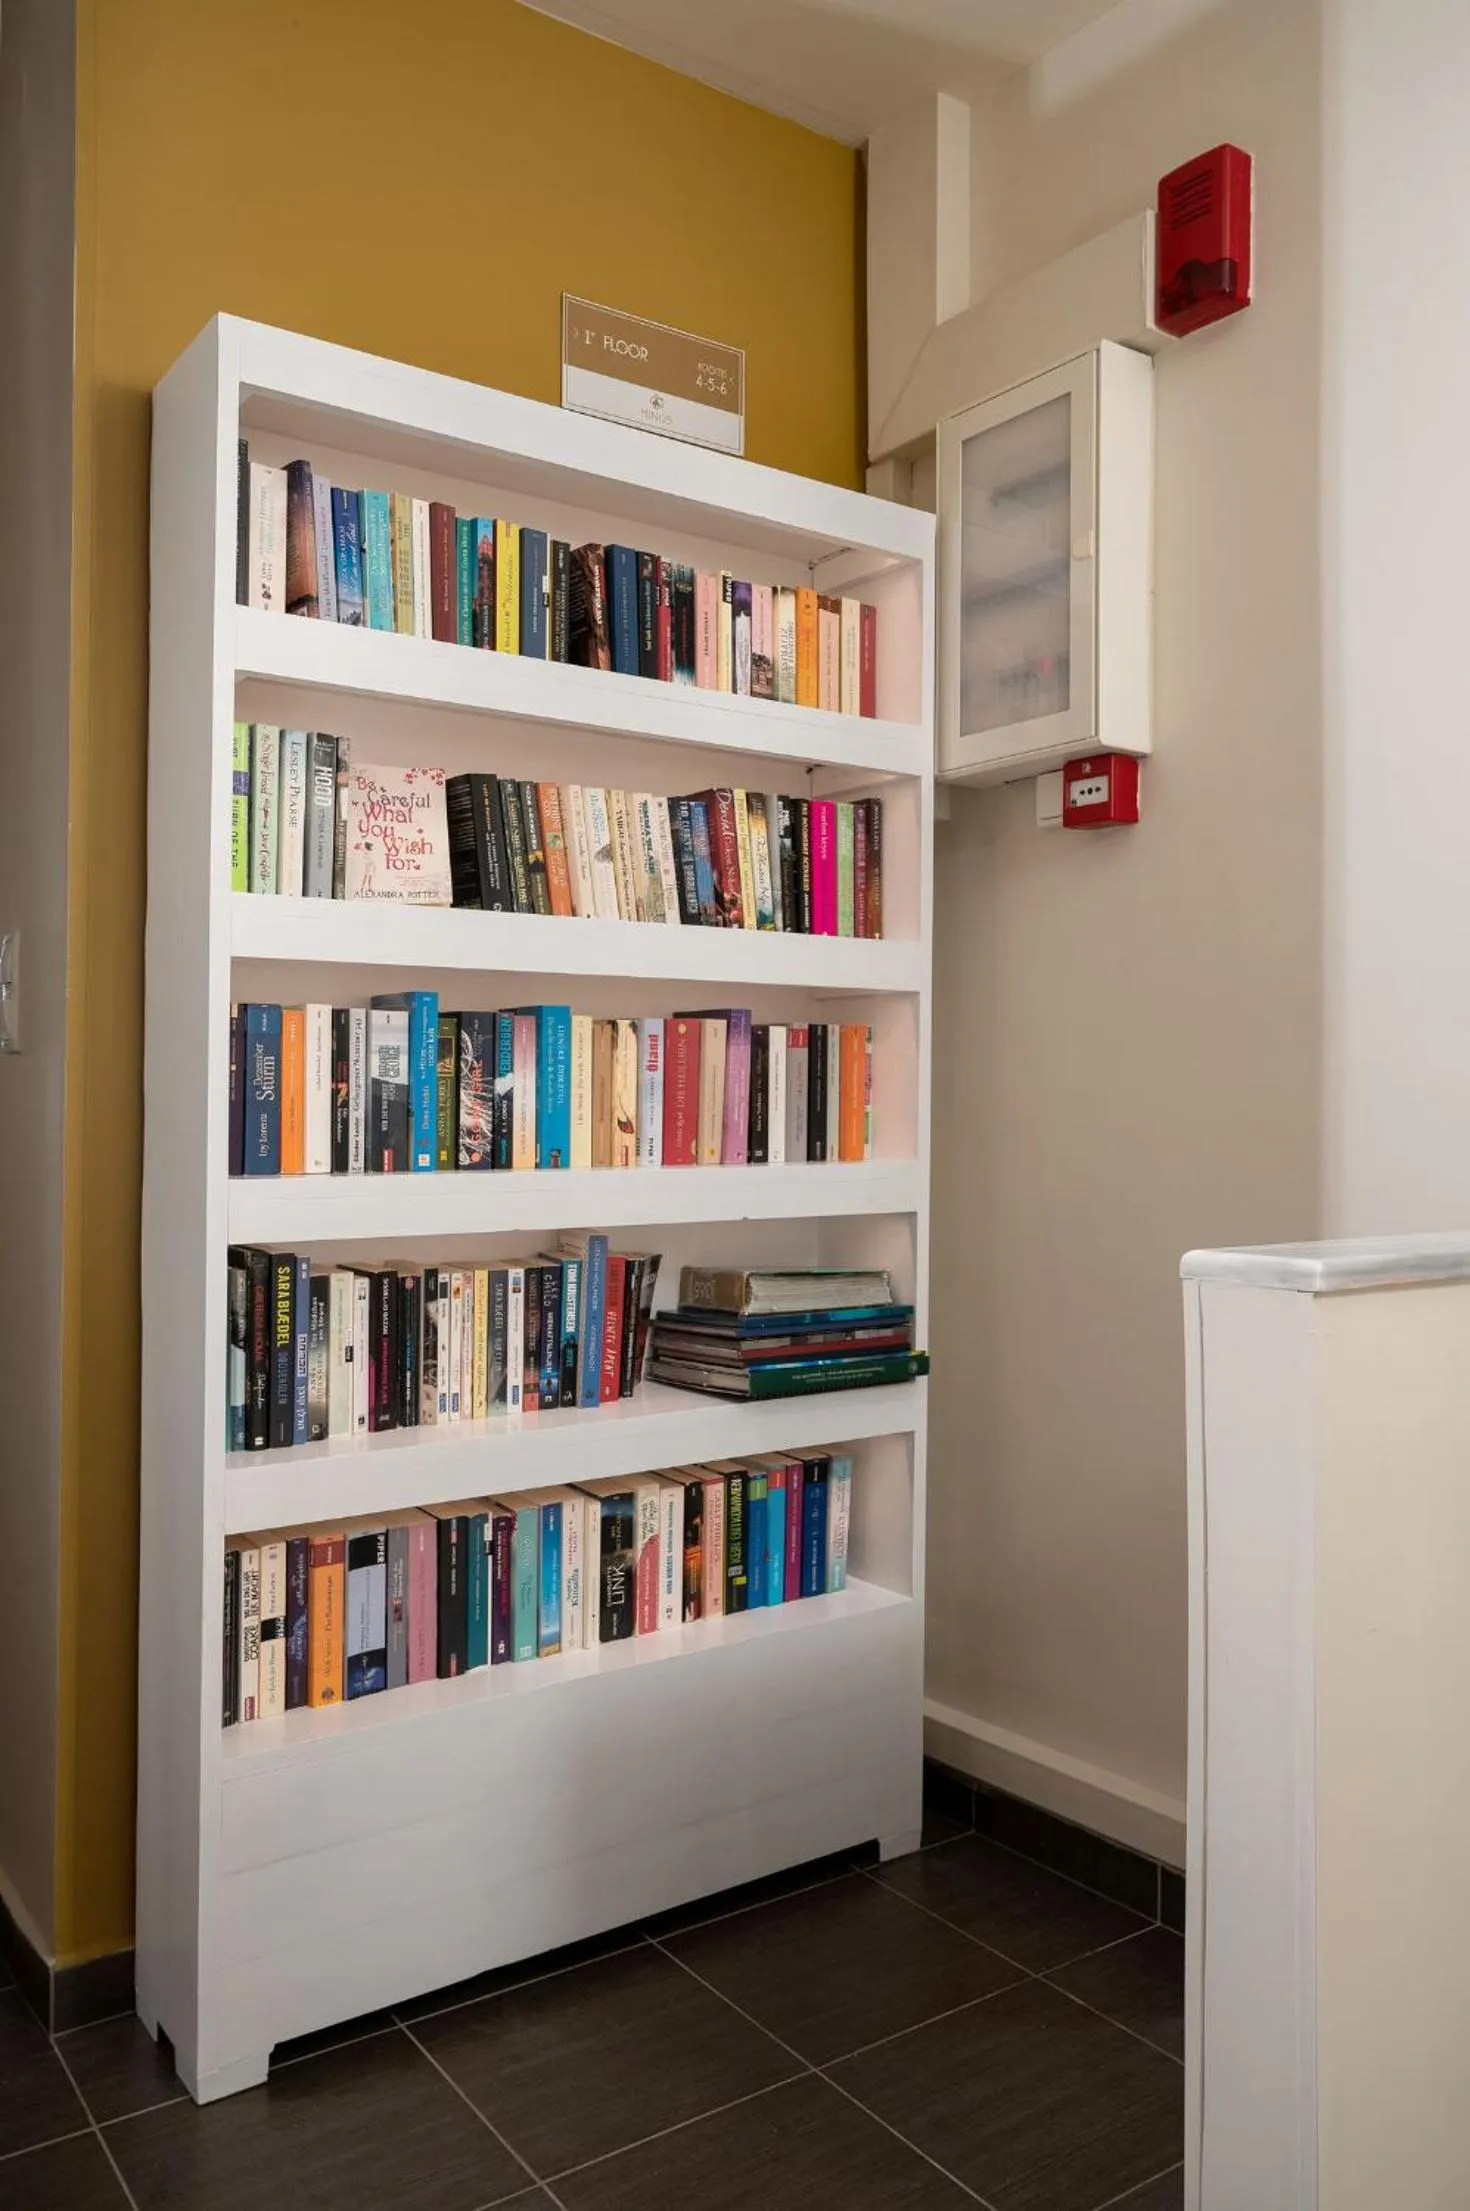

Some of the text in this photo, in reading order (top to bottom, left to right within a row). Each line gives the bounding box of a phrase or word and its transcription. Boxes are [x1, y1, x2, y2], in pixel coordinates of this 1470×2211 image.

[603, 335, 649, 362] FLOOR
[288, 742, 302, 828] LESLEY PEARSE
[314, 765, 333, 806] HOOD
[367, 790, 431, 809] Careful
[360, 802, 414, 824] What
[679, 800, 688, 818] TOM
[716, 790, 733, 837] Denial
[383, 836, 433, 856] Wish
[818, 836, 828, 860] keyes
[355, 888, 439, 899] ALEXANDRA POTTER
[253, 1042, 264, 1086] Dezember
[388, 1044, 400, 1078] GEORGE
[645, 1034, 659, 1072] Öland
[256, 1056, 276, 1100] Sturm
[438, 1079, 446, 1137] ANNE PERRY
[471, 1060, 483, 1144] GONE GIRL
[258, 1113, 270, 1157] Iny Lorentz
[276, 1266, 290, 1347] SARA BLÆDEL
[543, 1274, 552, 1306] CHILD
[566, 1263, 577, 1332] TOM KRISTENSEN
[603, 1347, 616, 1378] ÅPENT
[377, 1534, 385, 1564] PIPER
[251, 1570, 260, 1600] NACHT
[571, 1568, 579, 1608] Kinsella
[612, 1563, 625, 1605] LINK
[250, 1625, 259, 1660] COAKE
